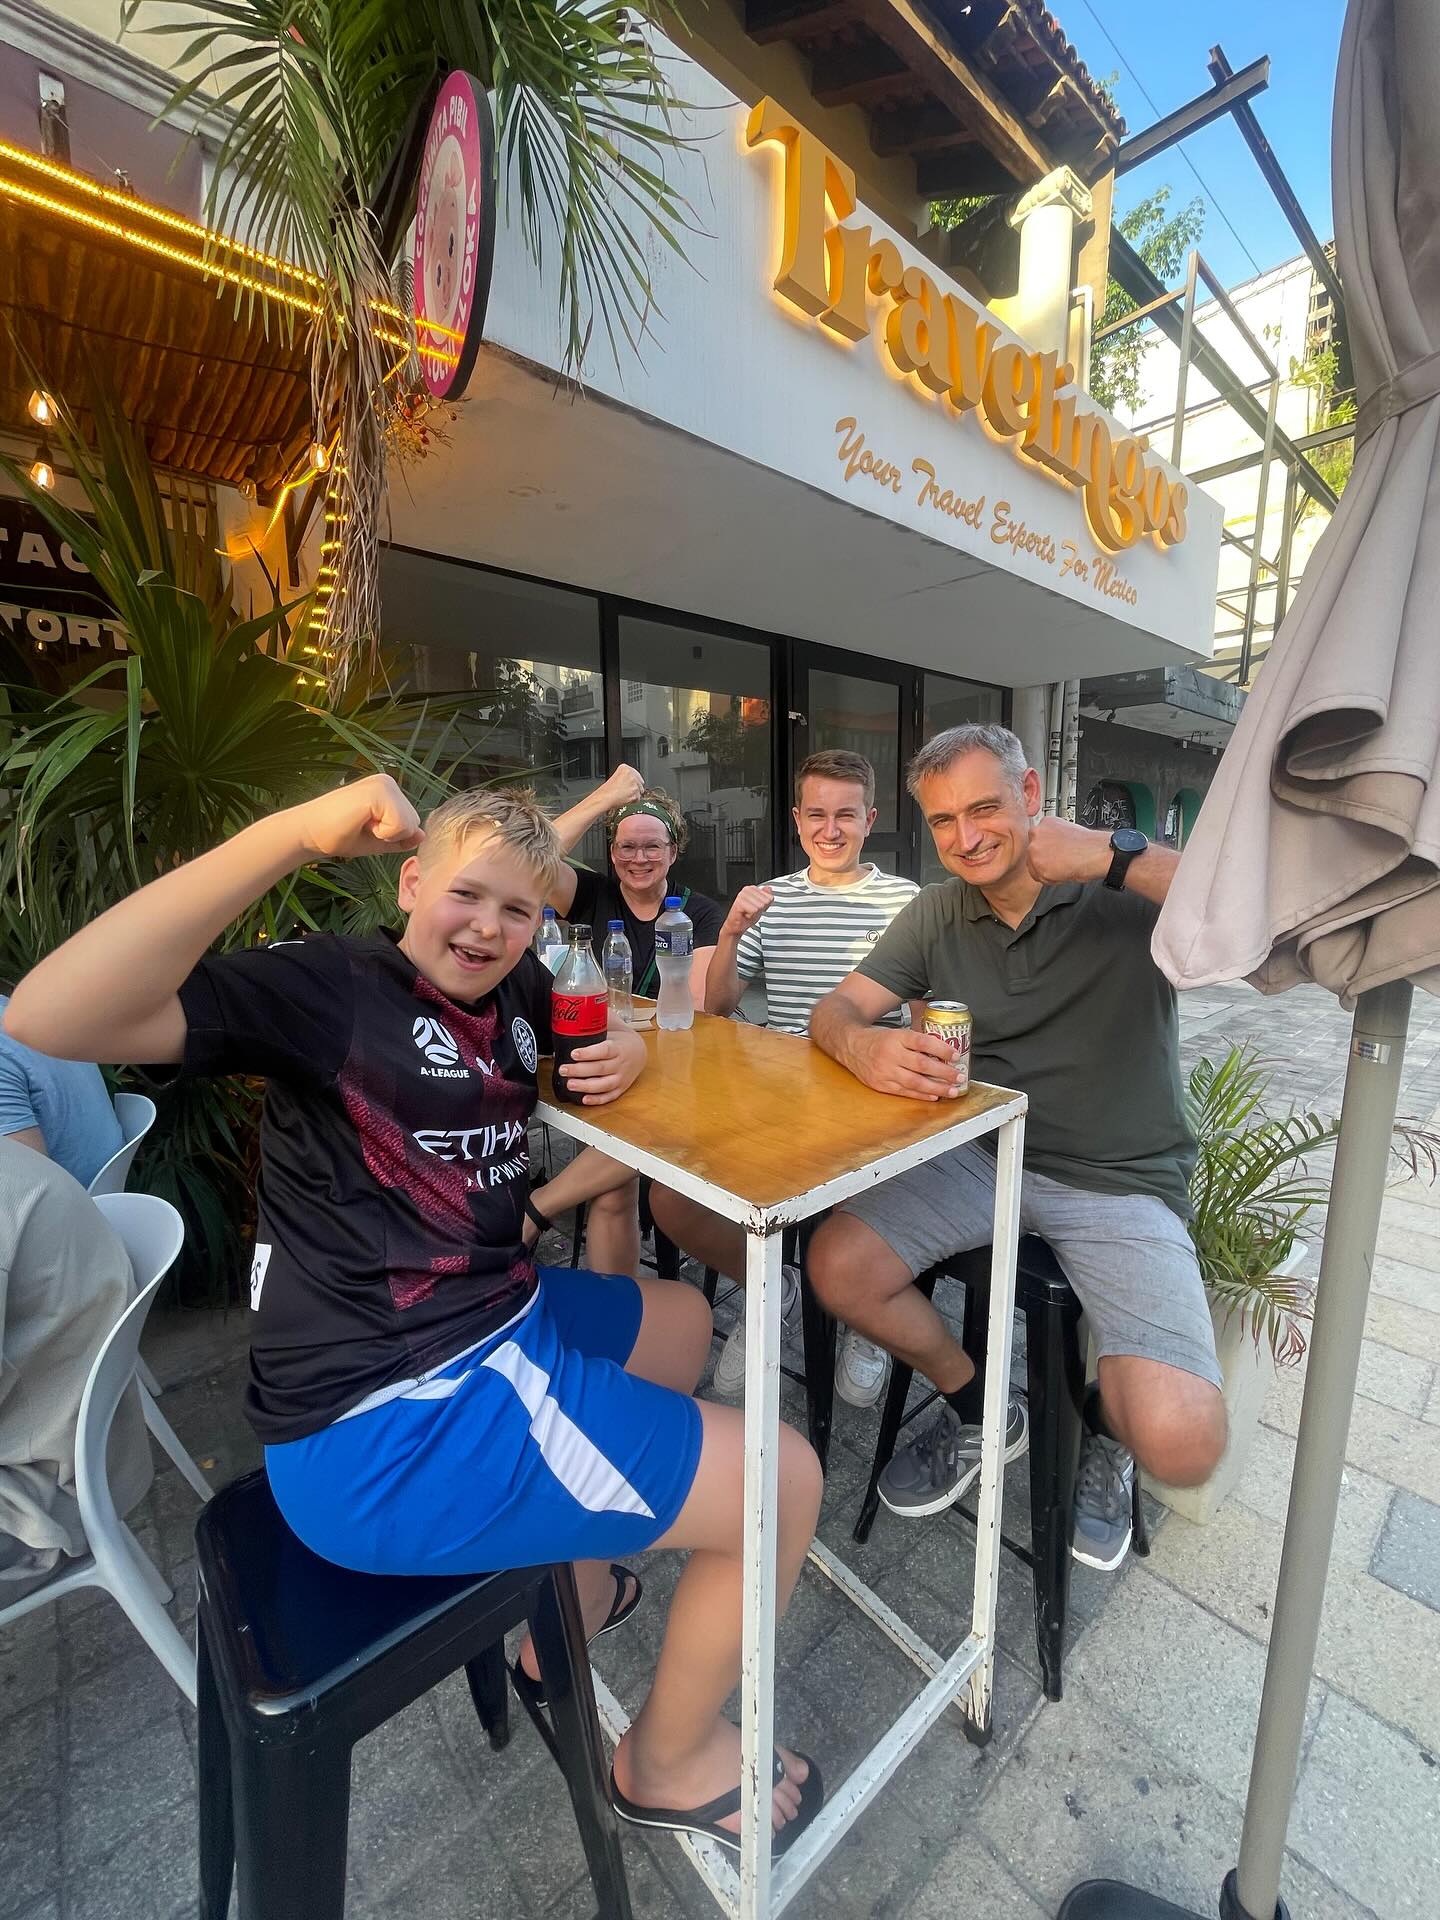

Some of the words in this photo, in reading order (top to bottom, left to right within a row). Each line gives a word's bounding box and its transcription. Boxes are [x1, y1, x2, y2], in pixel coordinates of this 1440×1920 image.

[449, 95, 469, 140] PIBIL
[746, 96, 1189, 552] Travelingos
[835, 416, 902, 493] Your
[911, 457, 986, 530] Travel
[1059, 539, 1089, 582] For
[412, 1116, 530, 1161] ETIHA
